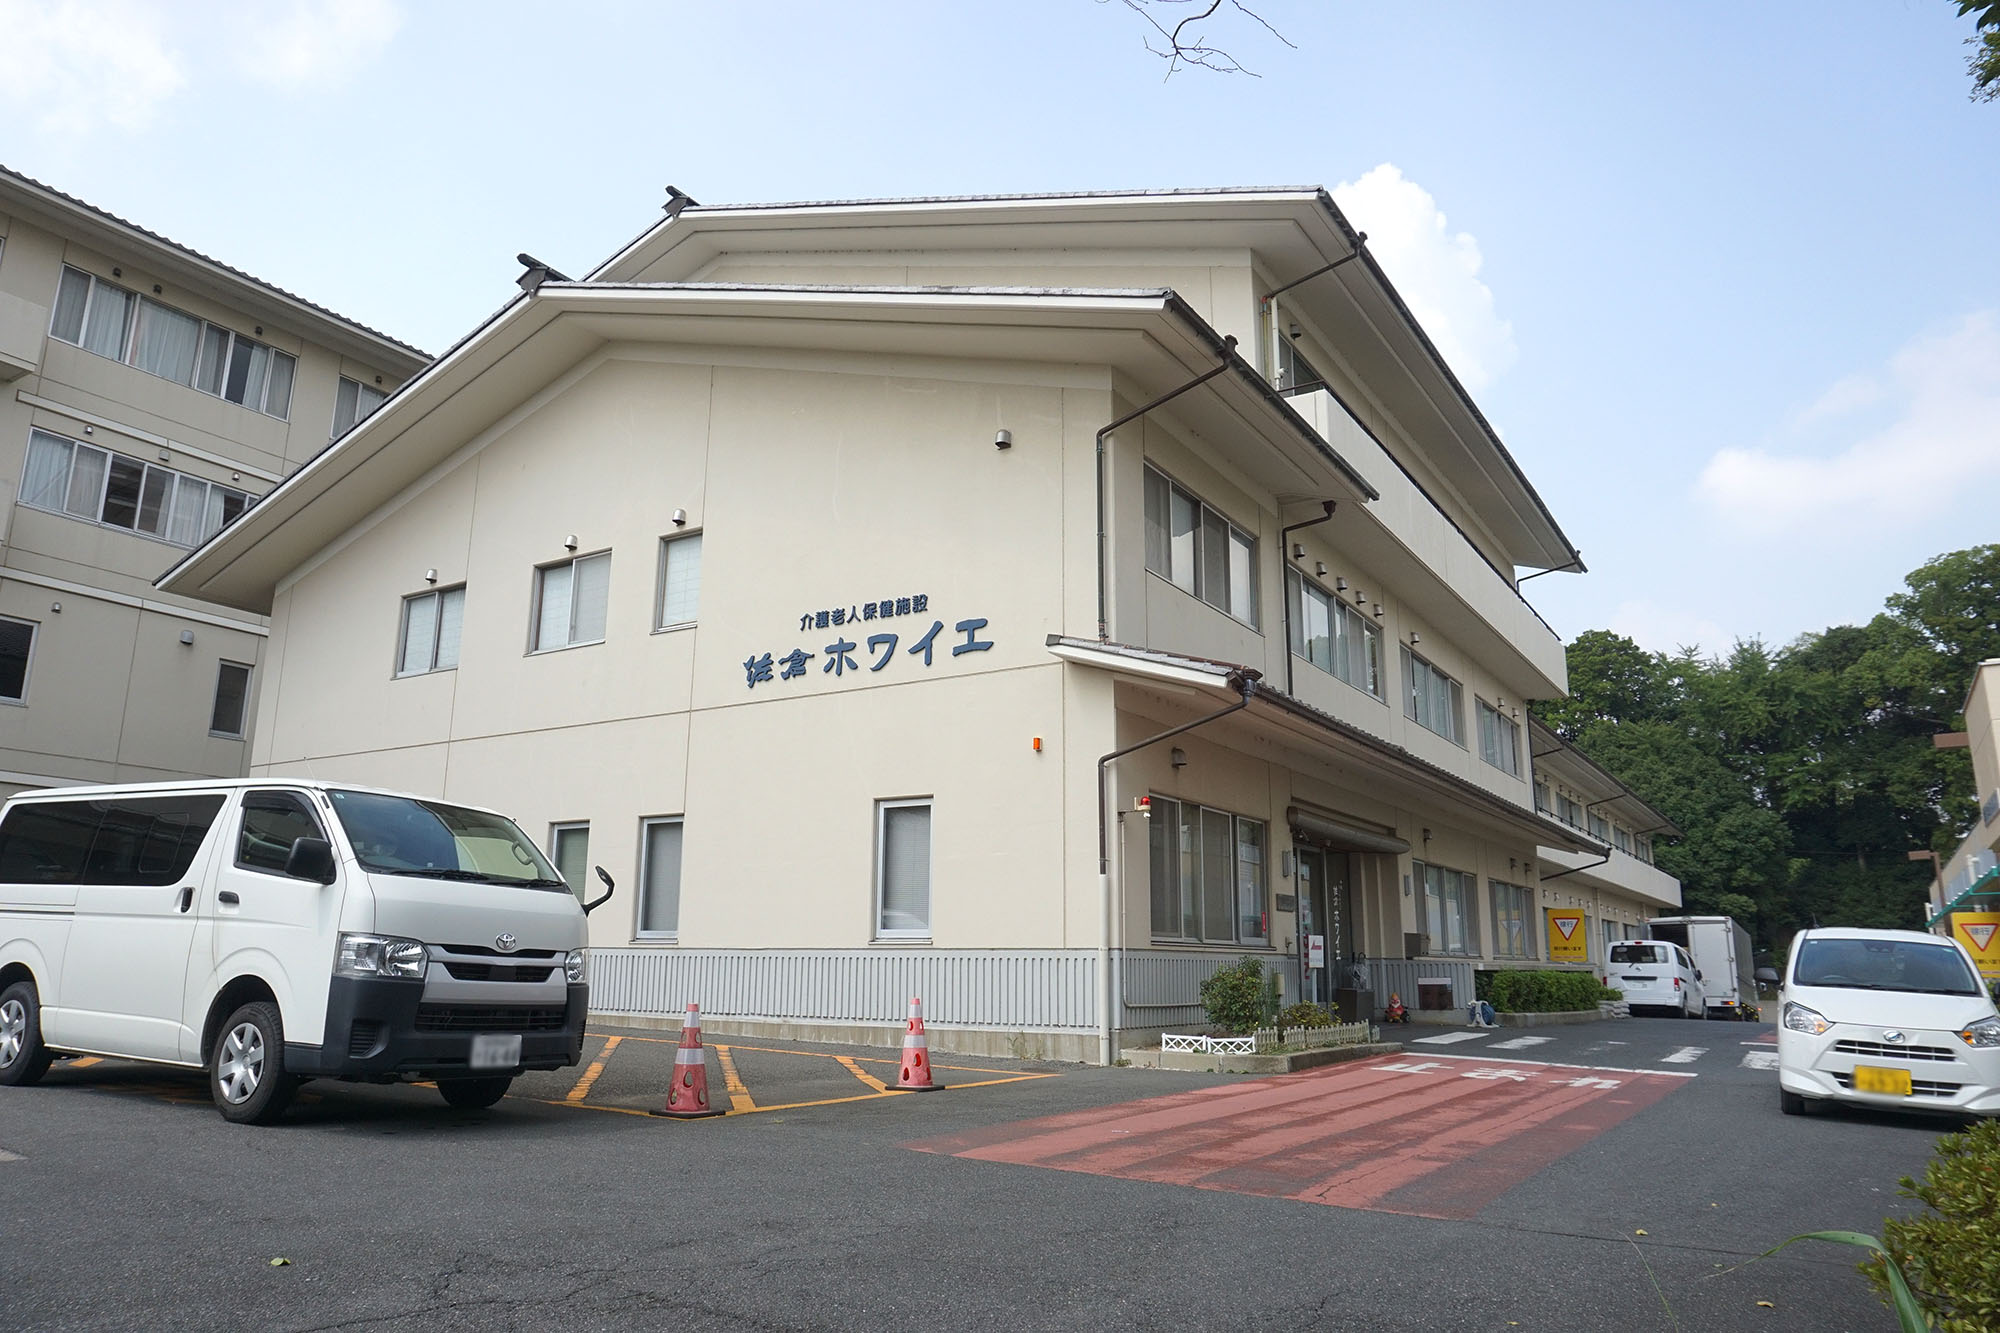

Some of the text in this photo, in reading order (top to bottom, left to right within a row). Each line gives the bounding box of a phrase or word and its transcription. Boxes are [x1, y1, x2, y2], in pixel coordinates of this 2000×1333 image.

[800, 594, 928, 631] 介護老人保健施設
[743, 618, 994, 687] 佐倉ホワイエ
